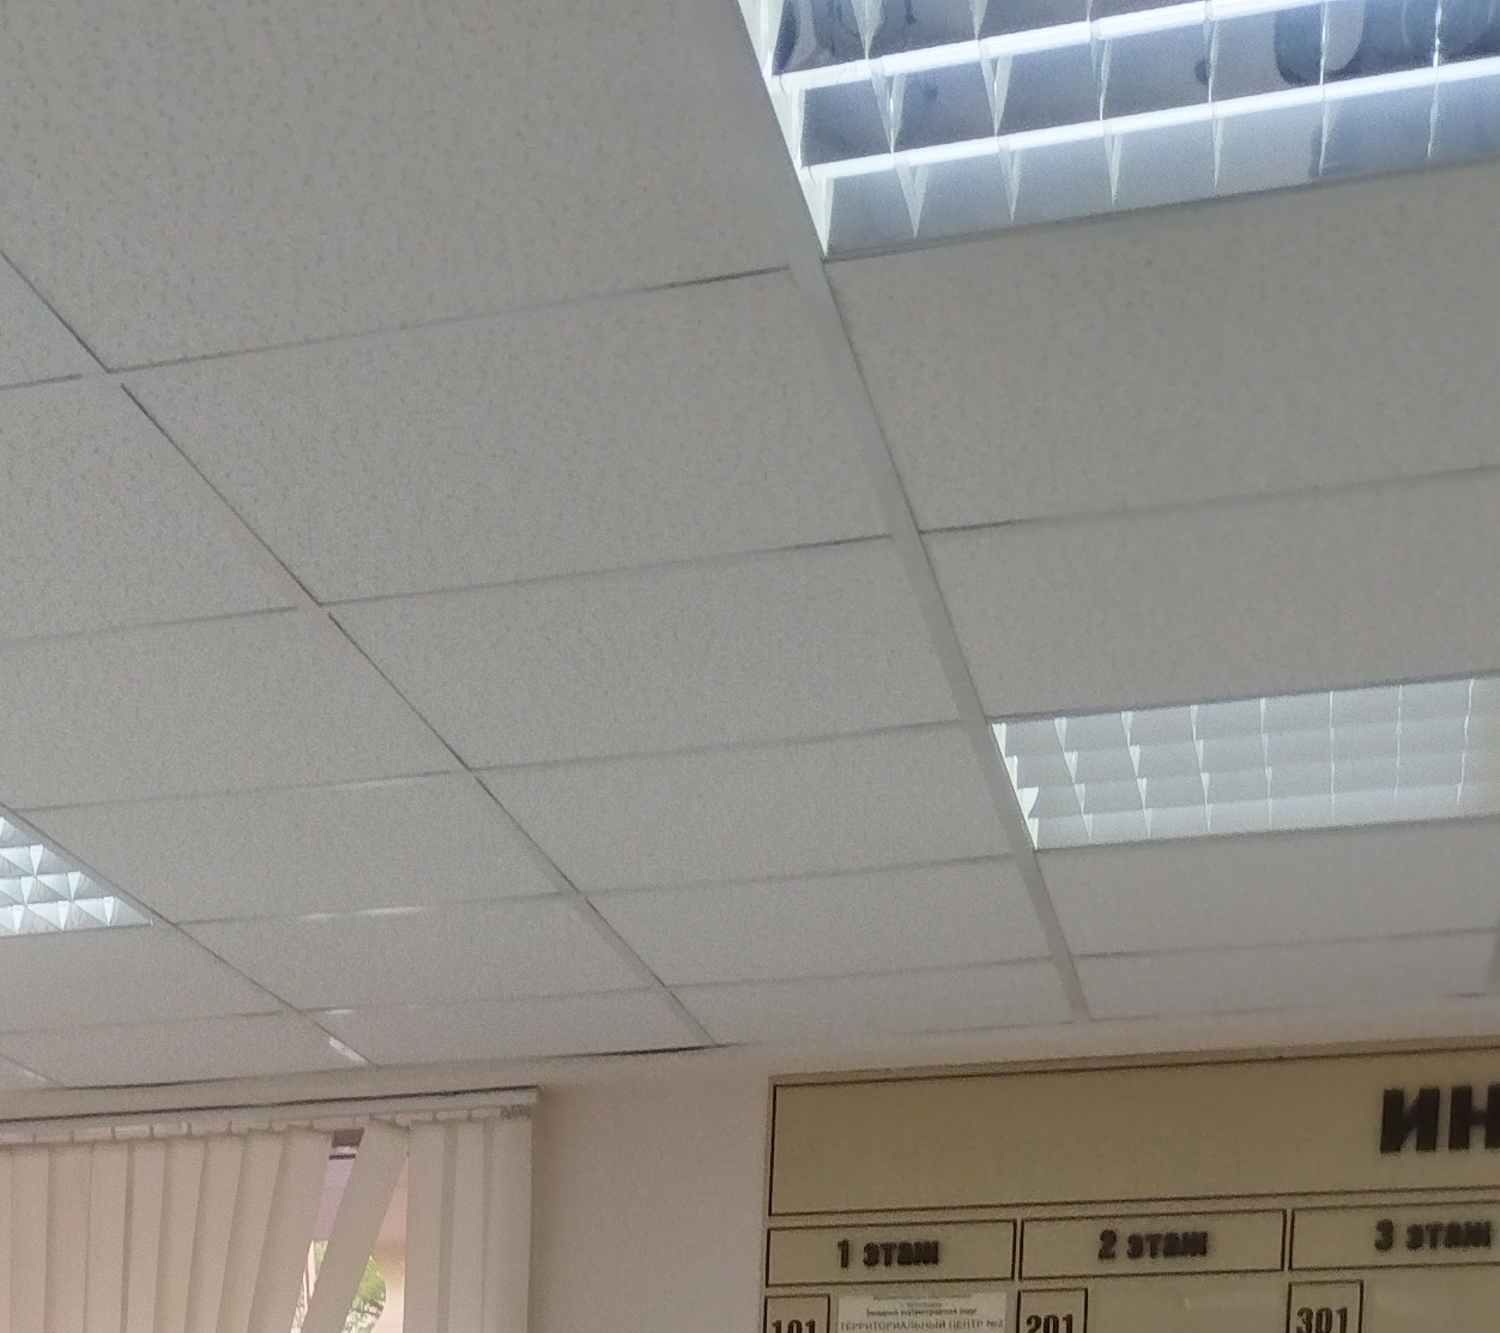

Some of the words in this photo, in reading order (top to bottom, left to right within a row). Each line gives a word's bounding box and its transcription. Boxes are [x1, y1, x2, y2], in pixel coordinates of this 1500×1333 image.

[1098, 1229, 1117, 1259] 2
[1374, 1218, 1394, 1251] 3
[838, 1239, 849, 1268] 1
